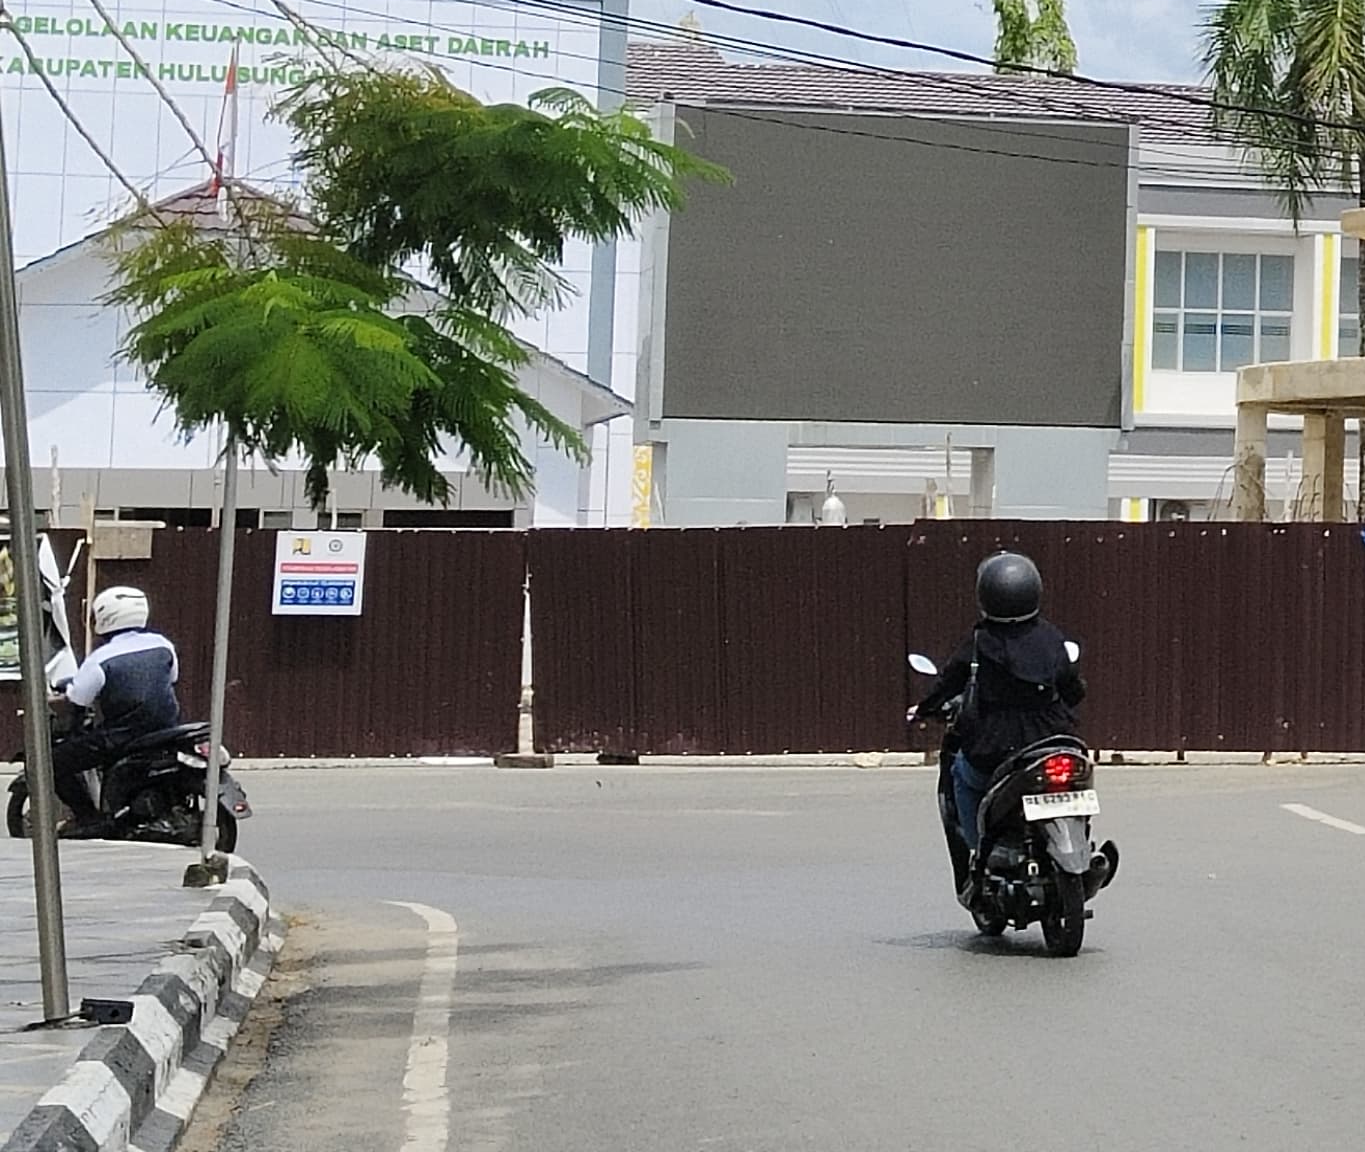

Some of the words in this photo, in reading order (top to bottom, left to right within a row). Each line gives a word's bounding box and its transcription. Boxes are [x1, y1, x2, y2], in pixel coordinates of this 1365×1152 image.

[376, 33, 440, 54] ASET
[448, 36, 549, 59] DAERAH
[0, 56, 151, 80] ABUPATEN
[158, 62, 226, 83] HULU
